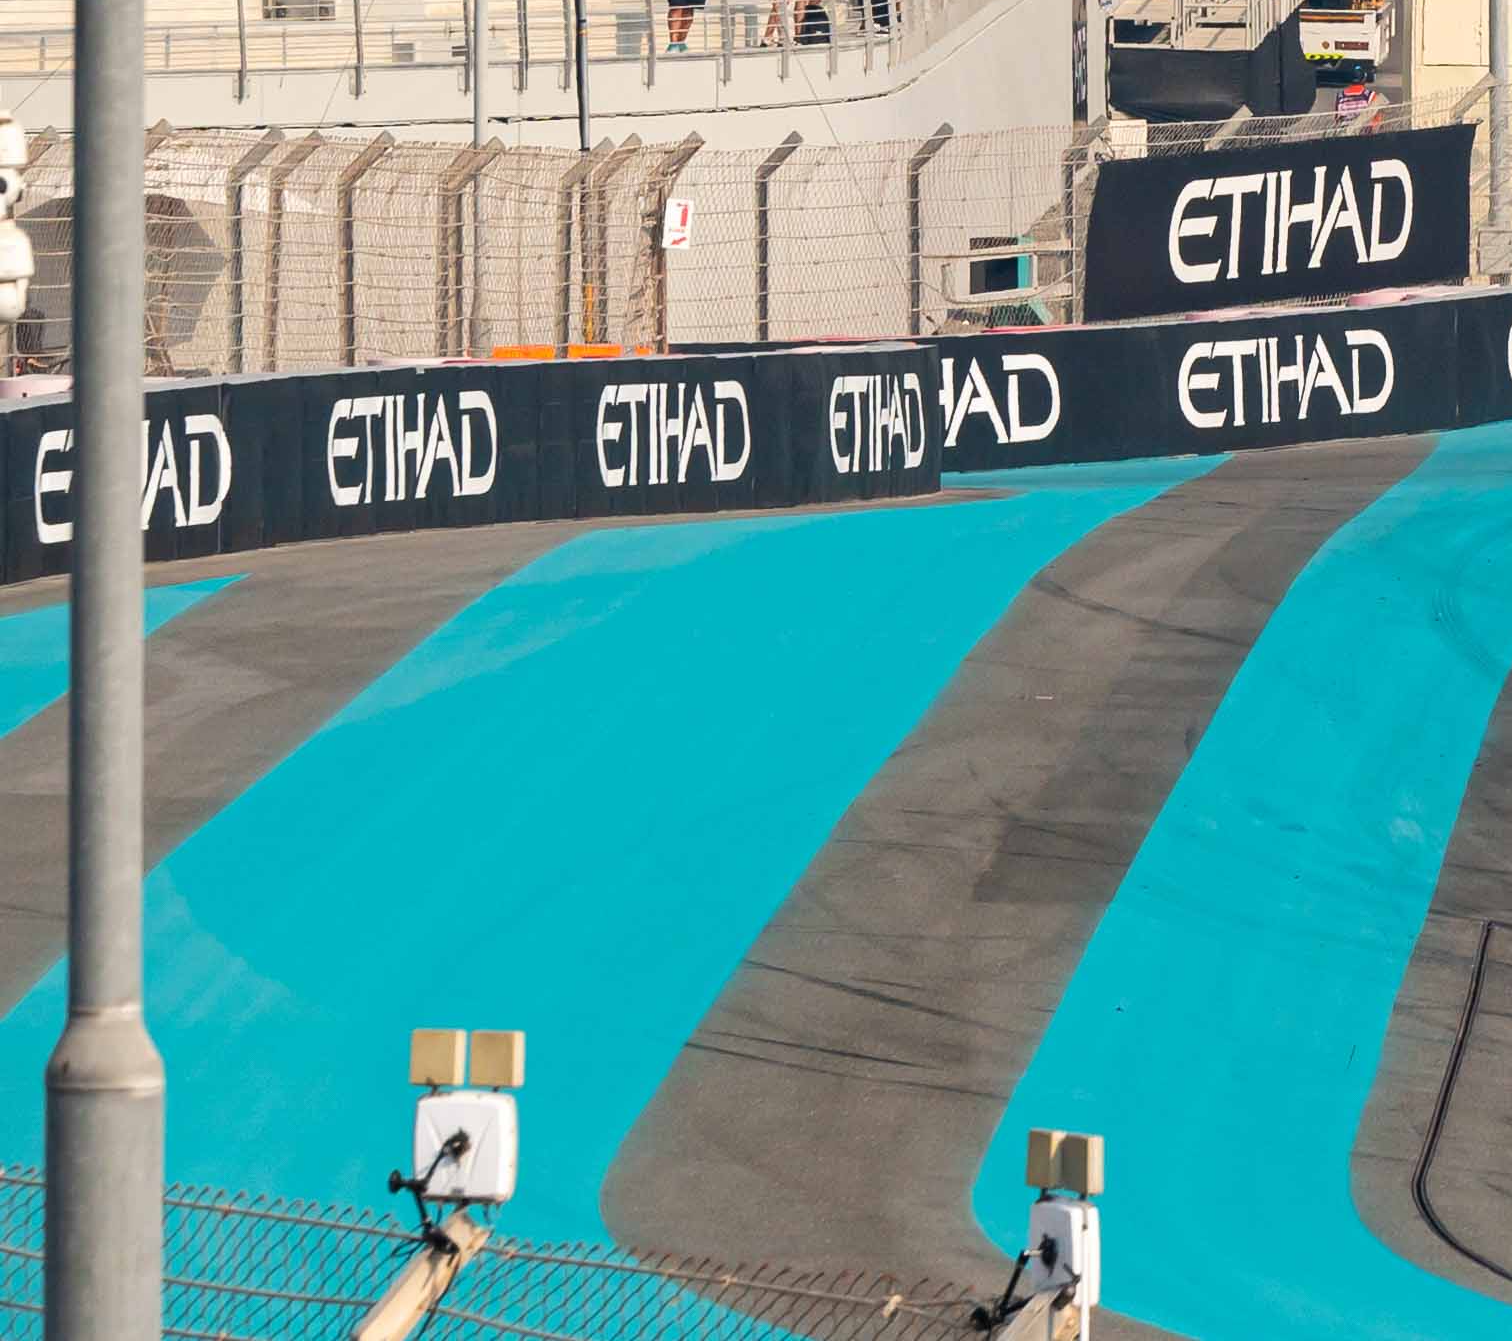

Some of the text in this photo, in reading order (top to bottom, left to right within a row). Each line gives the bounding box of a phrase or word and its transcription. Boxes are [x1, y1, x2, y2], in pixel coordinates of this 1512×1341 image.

[1168, 159, 1414, 285] ETIHAD
[328, 390, 498, 506] ETIHAD
[596, 379, 752, 488] ETIHAD
[829, 371, 926, 475] ETIHAD
[1178, 328, 1394, 429] ETIHAD
